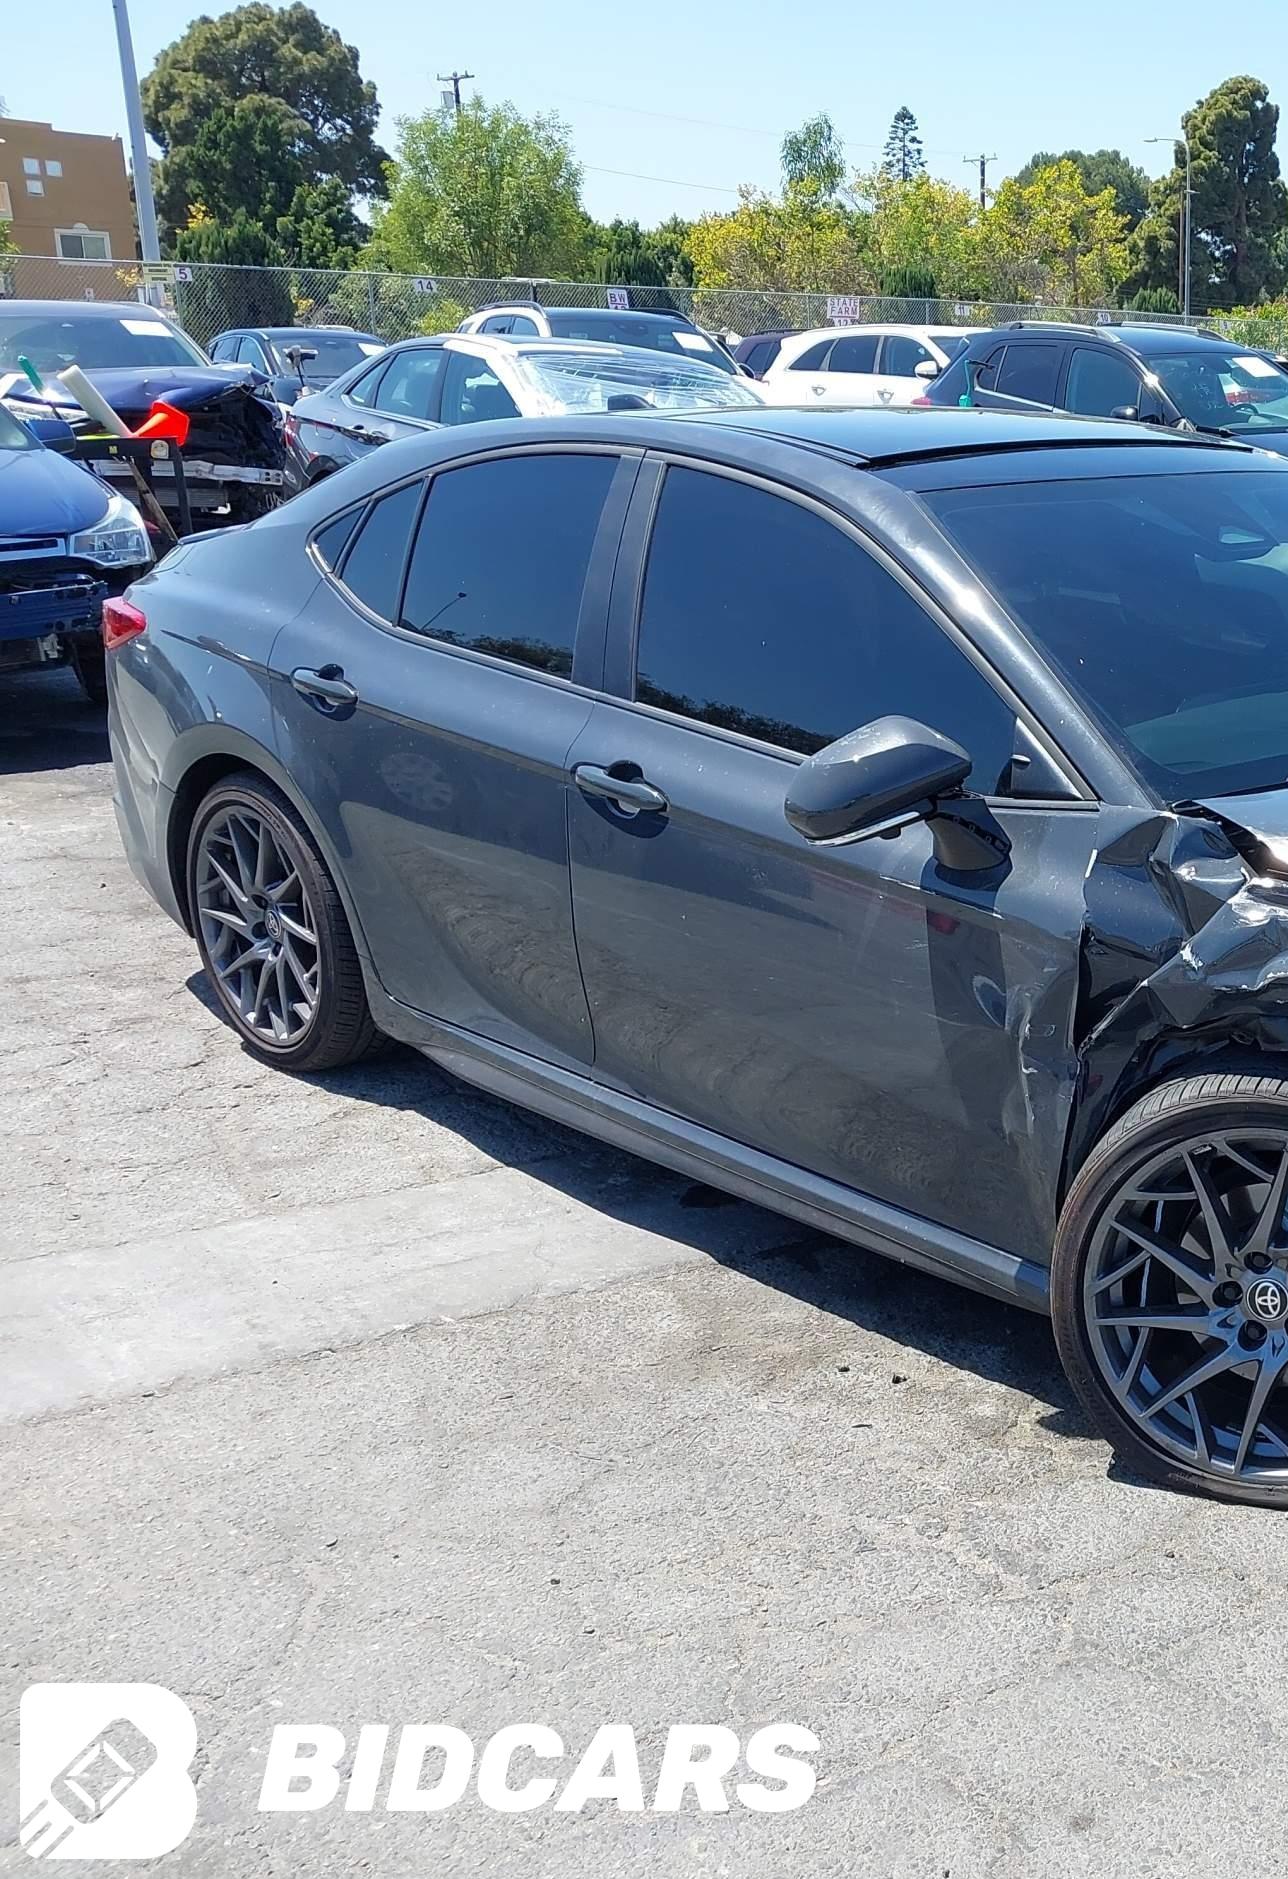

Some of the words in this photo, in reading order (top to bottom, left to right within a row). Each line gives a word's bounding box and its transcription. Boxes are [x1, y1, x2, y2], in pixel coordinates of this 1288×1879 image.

[417, 280, 433, 291] 14
[830, 298, 858, 306] STATE
[830, 306, 858, 315] FARM
